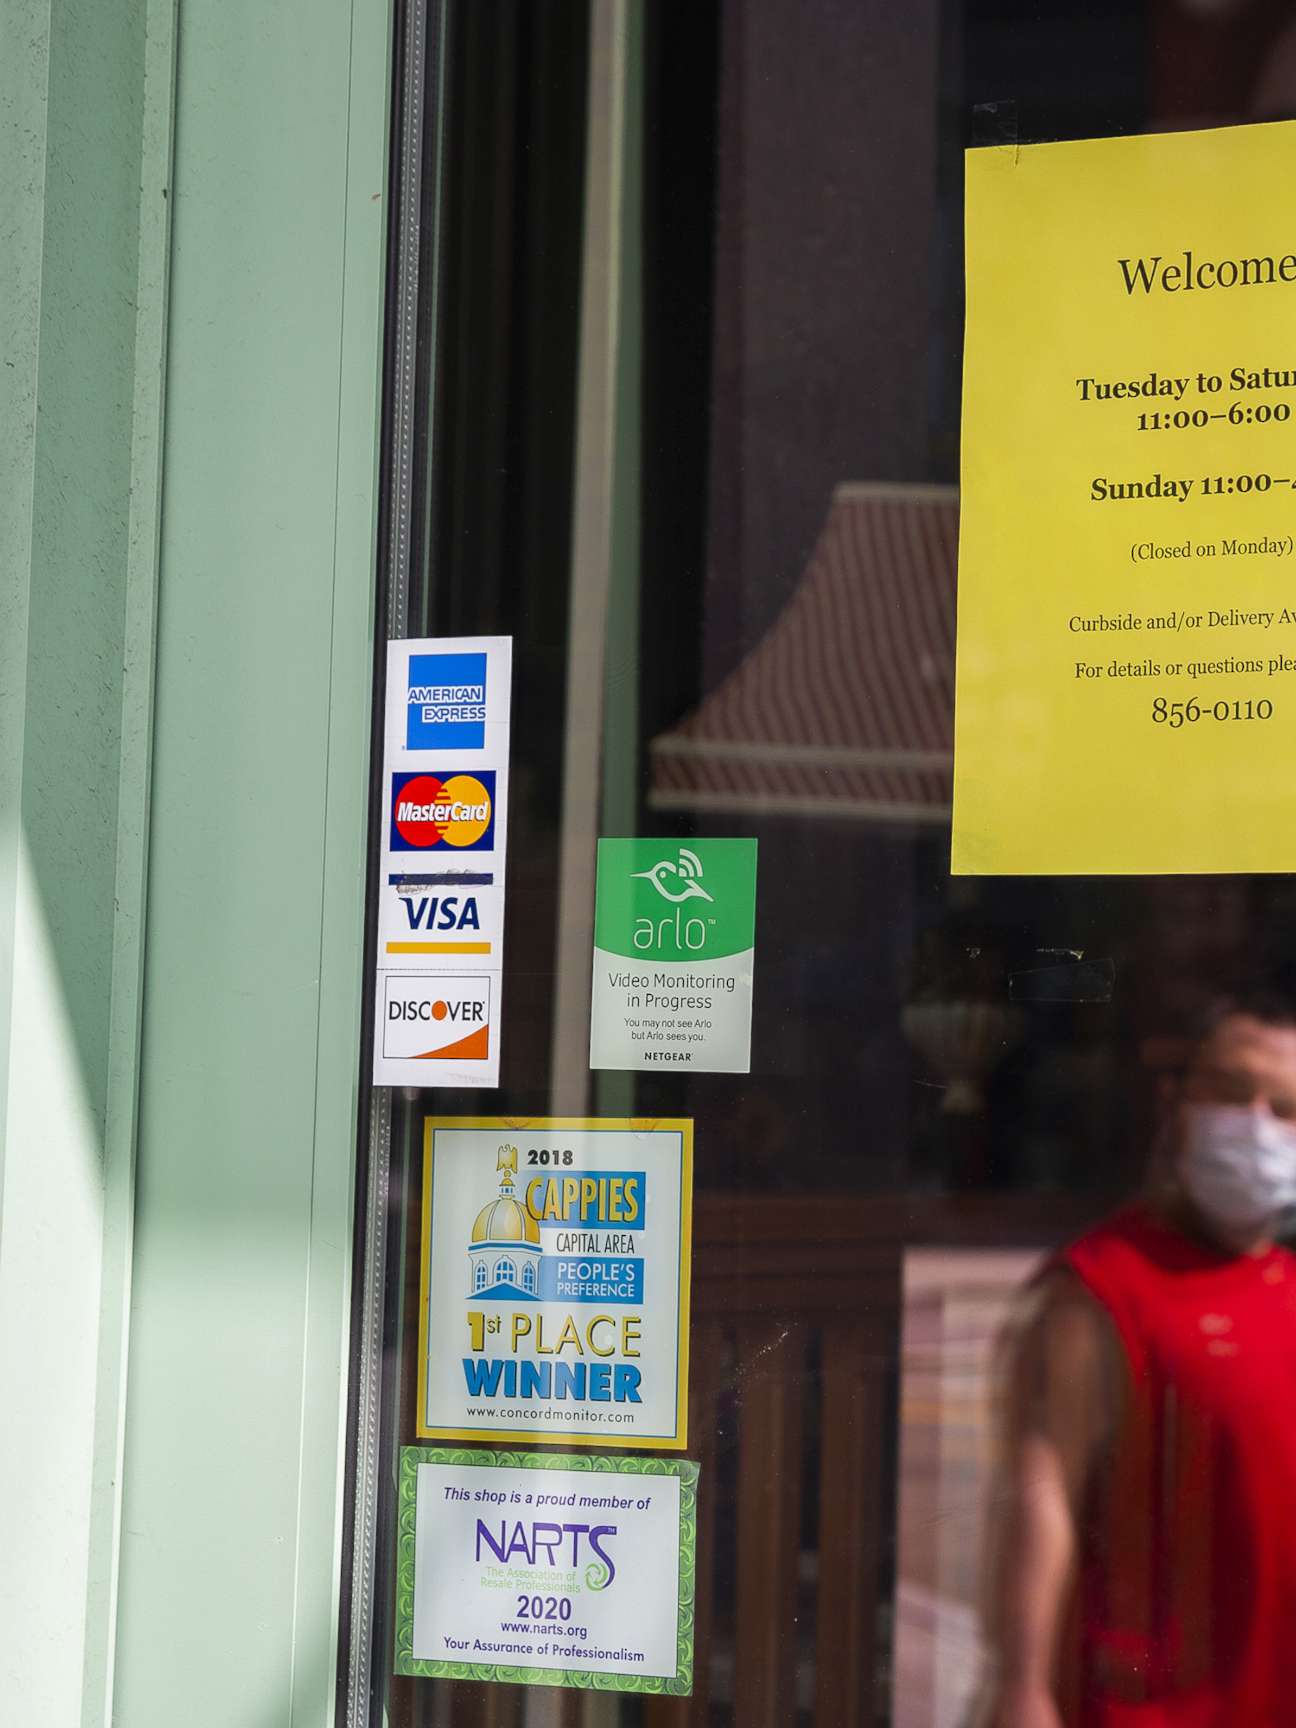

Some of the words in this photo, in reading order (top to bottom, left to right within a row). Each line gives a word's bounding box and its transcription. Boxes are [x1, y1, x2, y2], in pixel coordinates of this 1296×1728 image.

[1076, 373, 1190, 400] Tuesday
[1196, 374, 1222, 393] to
[1091, 474, 1193, 502] Sunday
[1132, 541, 1191, 563] (Closed
[1197, 545, 1216, 556] on
[1222, 536, 1293, 556] Monday)
[1070, 614, 1141, 632] Curbside
[1147, 612, 1202, 632] and/or
[1208, 609, 1274, 628] Delivery
[1076, 663, 1103, 678] For
[1108, 660, 1160, 677] details
[1166, 664, 1182, 675] or
[1187, 657, 1263, 679] questions
[408, 687, 481, 702] AMERICAN
[423, 706, 486, 721] EXPRESS
[1152, 697, 1272, 728] 856-0110
[396, 801, 488, 822] MasterCard
[399, 897, 480, 930] VISA
[634, 908, 705, 949] arlo
[609, 973, 649, 987] Video
[654, 974, 734, 992] Monitoring
[389, 999, 484, 1022] DISCOVER
[628, 993, 639, 1007] in
[646, 993, 711, 1011] Progress
[624, 1018, 639, 1027] You
[642, 1020, 660, 1029] may
[662, 1019, 675, 1027] not
[694, 1019, 712, 1028] Arlo
[632, 1031, 644, 1040] but
[647, 1031, 664, 1040] Arlo
[645, 1052, 690, 1061] NETGEAR
[528, 1150, 572, 1165] 2018
[525, 1176, 639, 1223] CAPPIES
[557, 1233, 601, 1253] CAPITAL
[604, 1234, 634, 1254] AREA
[557, 1262, 635, 1281] PEOPLE'S
[556, 1282, 634, 1297] PREFERENCE
[467, 1311, 501, 1352] 1st
[511, 1312, 641, 1357] PLACE
[462, 1358, 642, 1403] WINNER
[467, 1408, 633, 1422] www.concordmonitor.com
[445, 1487, 470, 1500] This
[474, 1489, 506, 1505] shop
[510, 1491, 521, 1503] is
[525, 1495, 532, 1503] a
[536, 1494, 576, 1507] proud
[579, 1496, 630, 1508] member
[636, 1498, 651, 1509] of
[475, 1518, 617, 1590] NARTS
[486, 1566, 505, 1578] The
[480, 1577, 513, 1590] Resale
[515, 1579, 581, 1594] Professionals
[517, 1595, 571, 1620] 2020
[501, 1623, 587, 1640] www.narts.org
[444, 1637, 470, 1649] Your
[473, 1639, 532, 1653] Assurance
[537, 1643, 548, 1654] of
[553, 1644, 644, 1661] Professionalism
